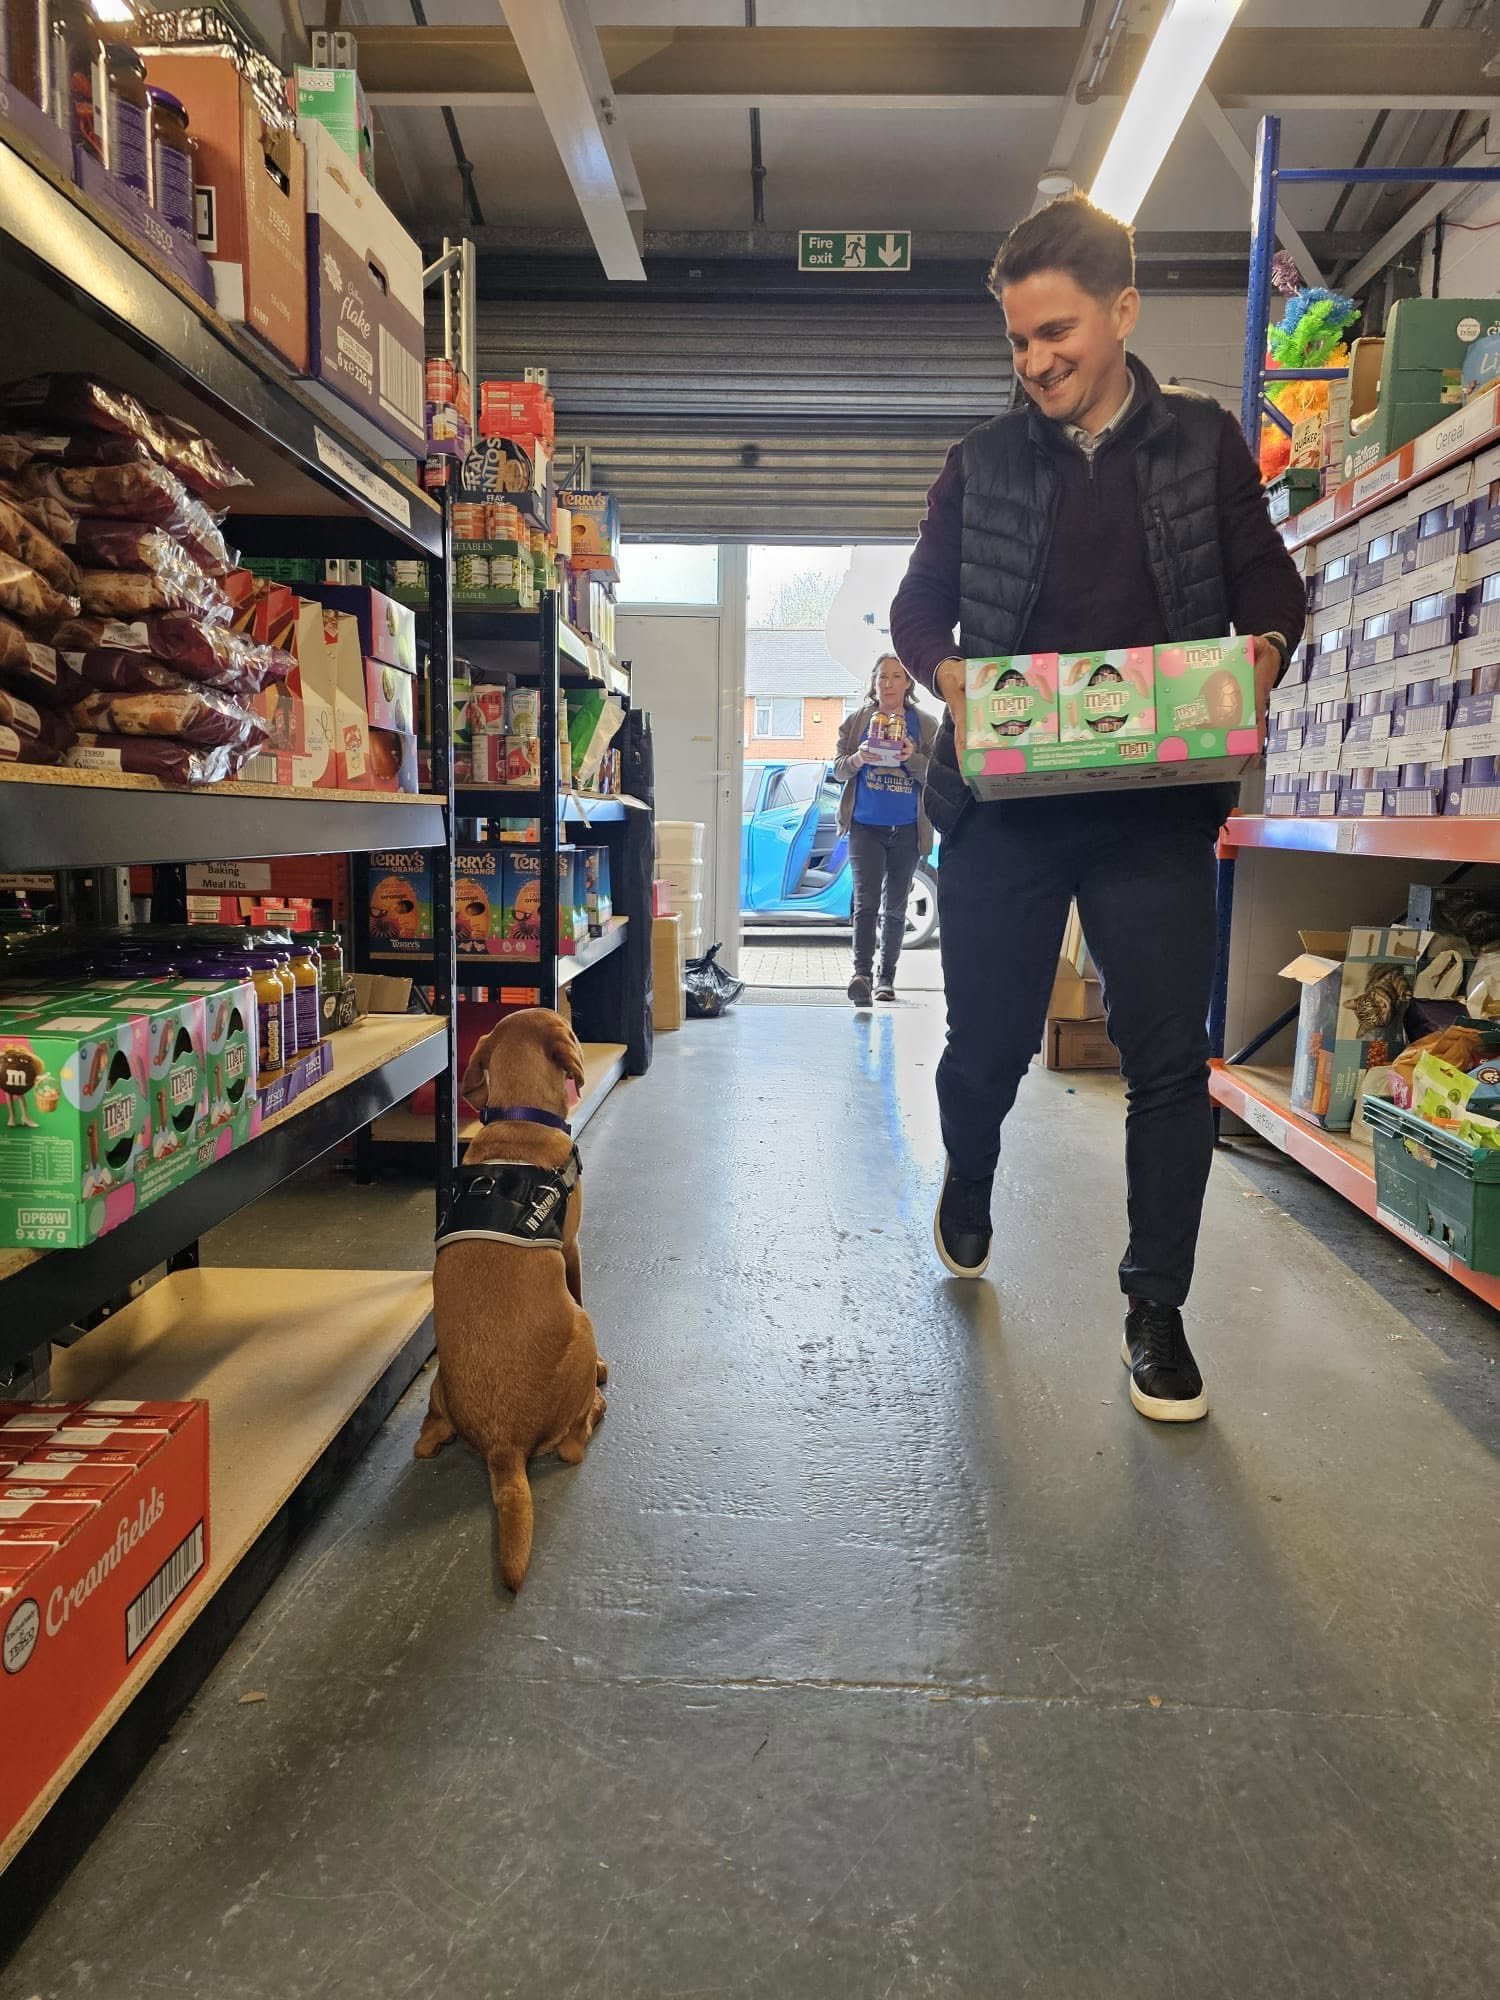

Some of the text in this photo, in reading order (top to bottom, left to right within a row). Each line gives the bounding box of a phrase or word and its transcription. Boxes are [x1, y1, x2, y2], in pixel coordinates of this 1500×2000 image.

[268, 206, 291, 238] TESCO
[143, 212, 174, 250] TESCO
[809, 236, 834, 249] Fire
[809, 252, 833, 264] exit
[340, 297, 371, 340] flake
[1435, 418, 1466, 451] Cereal
[1294, 434, 1318, 453] QUAKER
[75, 760, 82, 769] 6
[207, 865, 240, 877] Baking
[463, 868, 496, 876] ORANGE
[202, 880, 246, 889] Meal Kits
[266, 1088, 285, 1105] TESCO
[21, 1212, 67, 1226] DP69W
[525, 1218, 540, 1232] IN
[16, 1228, 67, 1243] 9 x 97 g
[45, 1486, 165, 1637] Creamfields
[9, 1627, 36, 1658] TESCO
